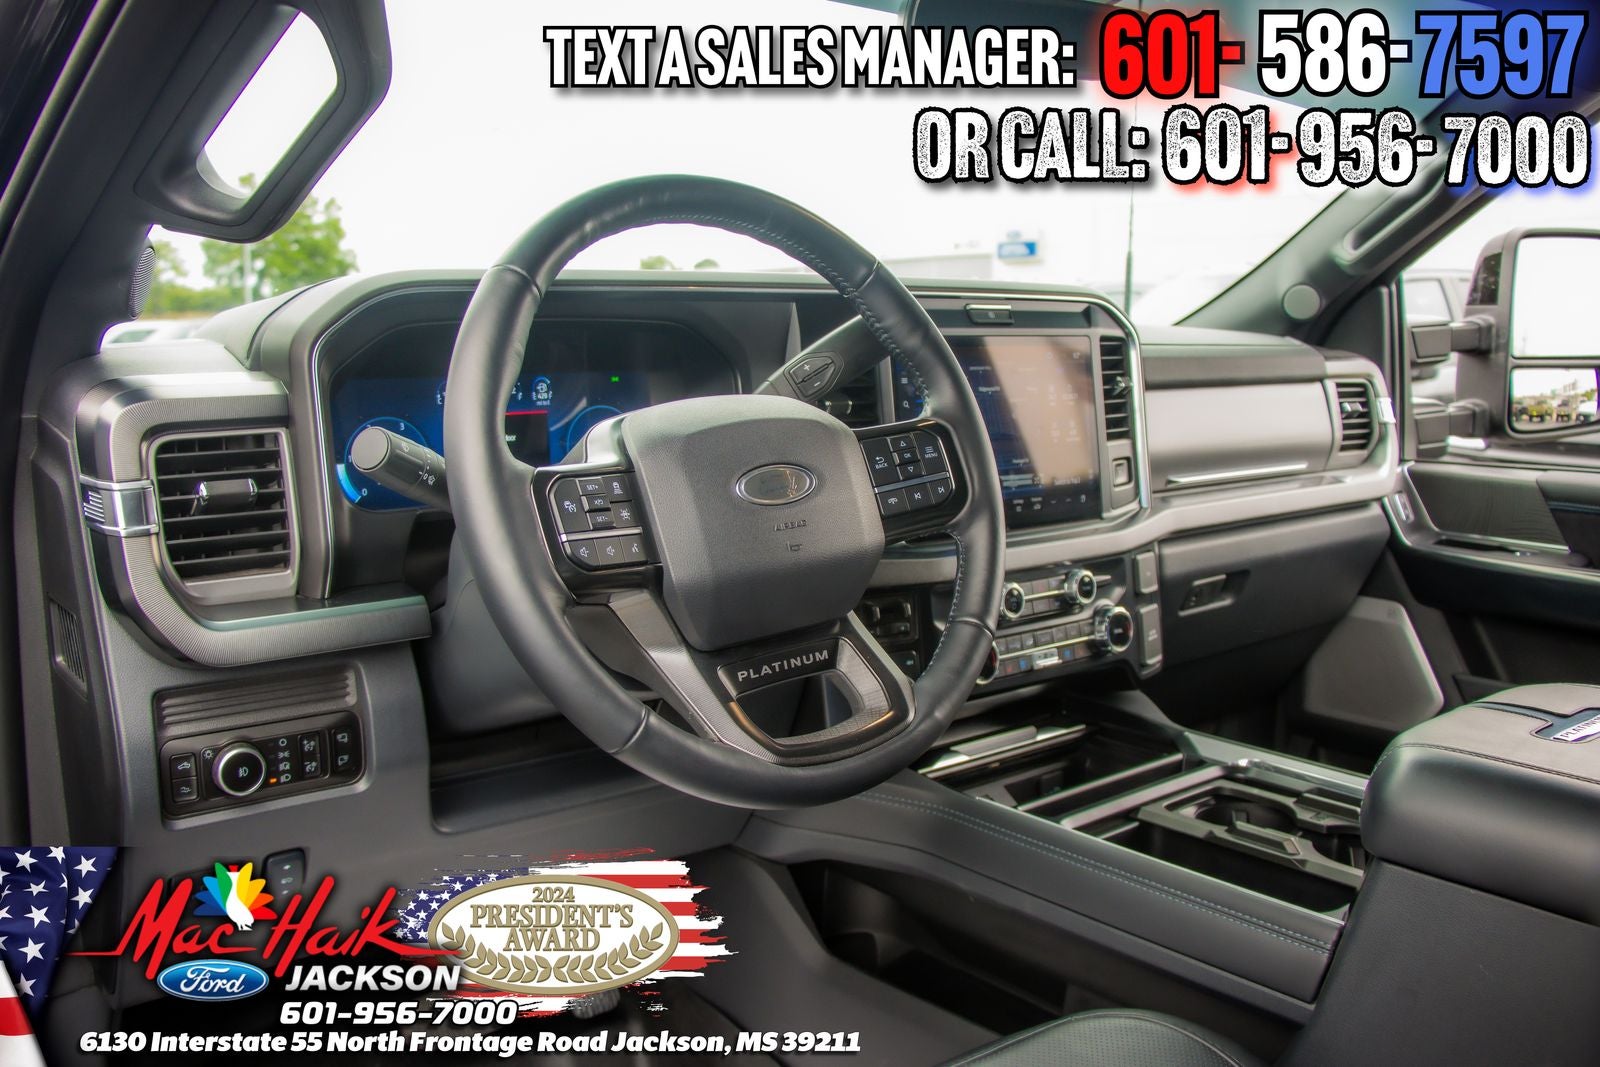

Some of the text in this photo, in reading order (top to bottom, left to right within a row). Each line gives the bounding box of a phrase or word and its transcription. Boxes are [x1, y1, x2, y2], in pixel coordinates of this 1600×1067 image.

[924, 451, 939, 459] MENU
[875, 462, 889, 470] BACK
[737, 649, 830, 682] PLATINUM
